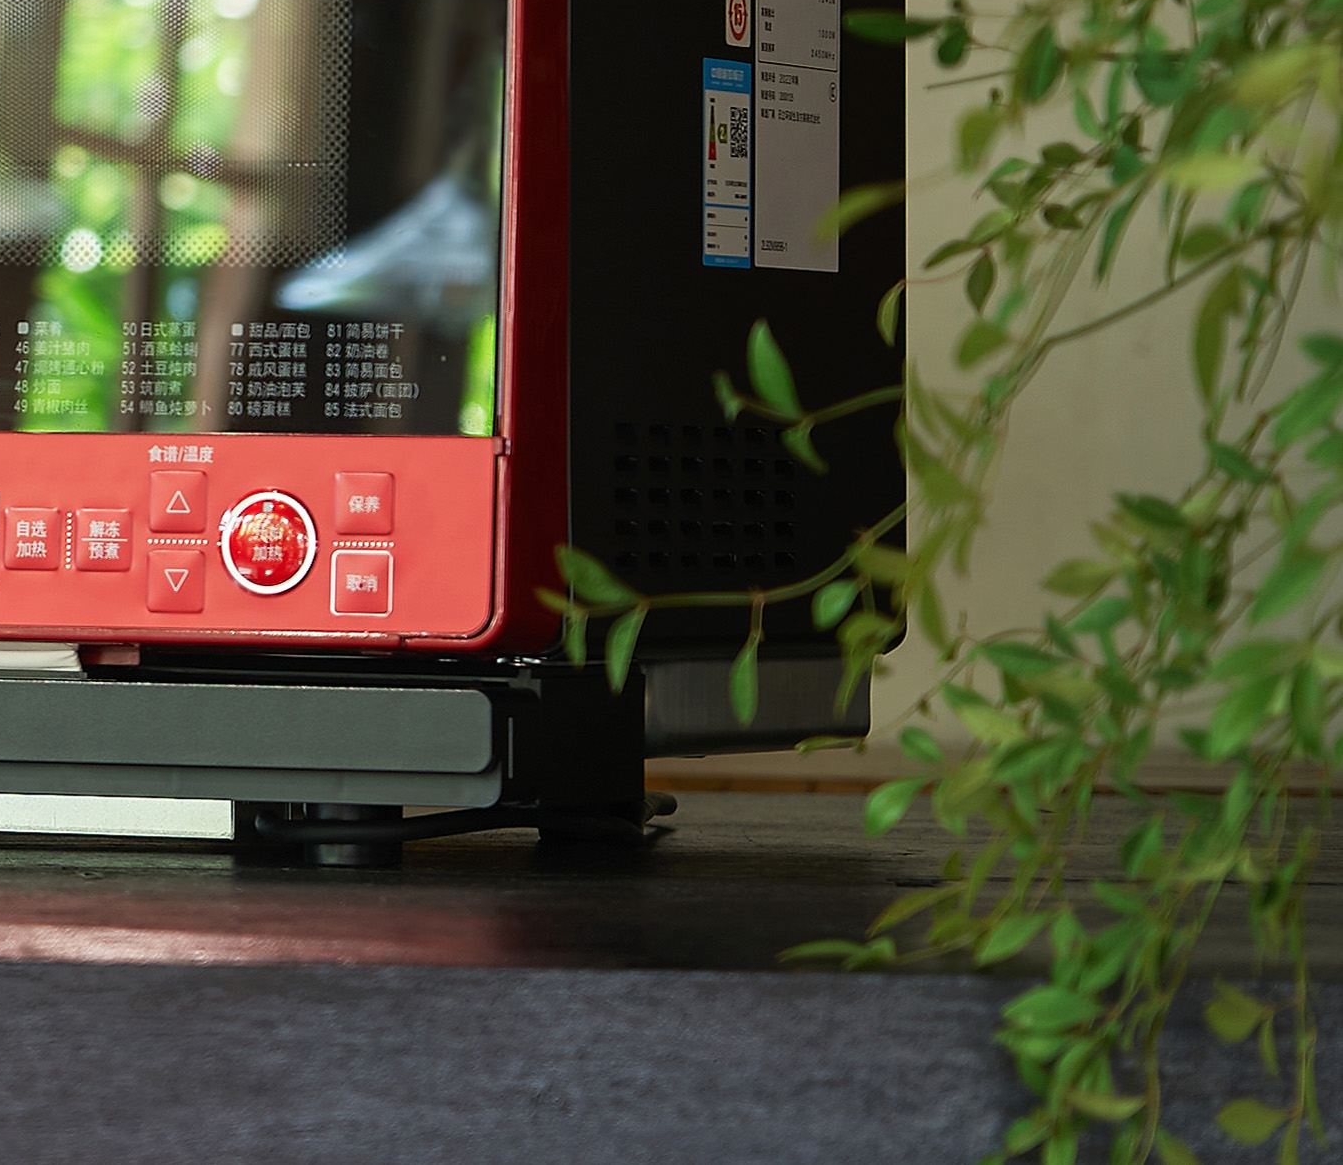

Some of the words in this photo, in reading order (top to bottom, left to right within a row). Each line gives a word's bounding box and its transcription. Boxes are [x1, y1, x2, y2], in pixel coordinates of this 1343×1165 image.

[35, 322, 63, 336] 菜肴
[123, 323, 136, 336] 50
[327, 324, 341, 337] 81
[16, 341, 29, 355] 46
[123, 343, 136, 356] 51
[230, 343, 244, 357] 77
[326, 344, 341, 357] 82
[15, 361, 29, 374] 47
[122, 362, 135, 375] 52
[230, 362, 244, 376] 78
[326, 364, 340, 378] 83
[14, 381, 28, 393] 48
[33, 380, 61, 394] 炒面
[121, 382, 135, 395] 53
[229, 382, 243, 396] 79
[325, 383, 340, 397] 84
[14, 400, 28, 413] 49
[121, 401, 134, 414] 54
[227, 401, 243, 415] 80
[325, 402, 340, 416] 85
[148, 445, 213, 463] 食谱/温度
[349, 496, 379, 513] 保养
[17, 521, 47, 537] 自选
[89, 521, 120, 538] 解冻
[17, 541, 47, 558] 加热
[89, 543, 120, 559] 预煮
[252, 546, 283, 561] 加热
[346, 575, 378, 592] 取消
